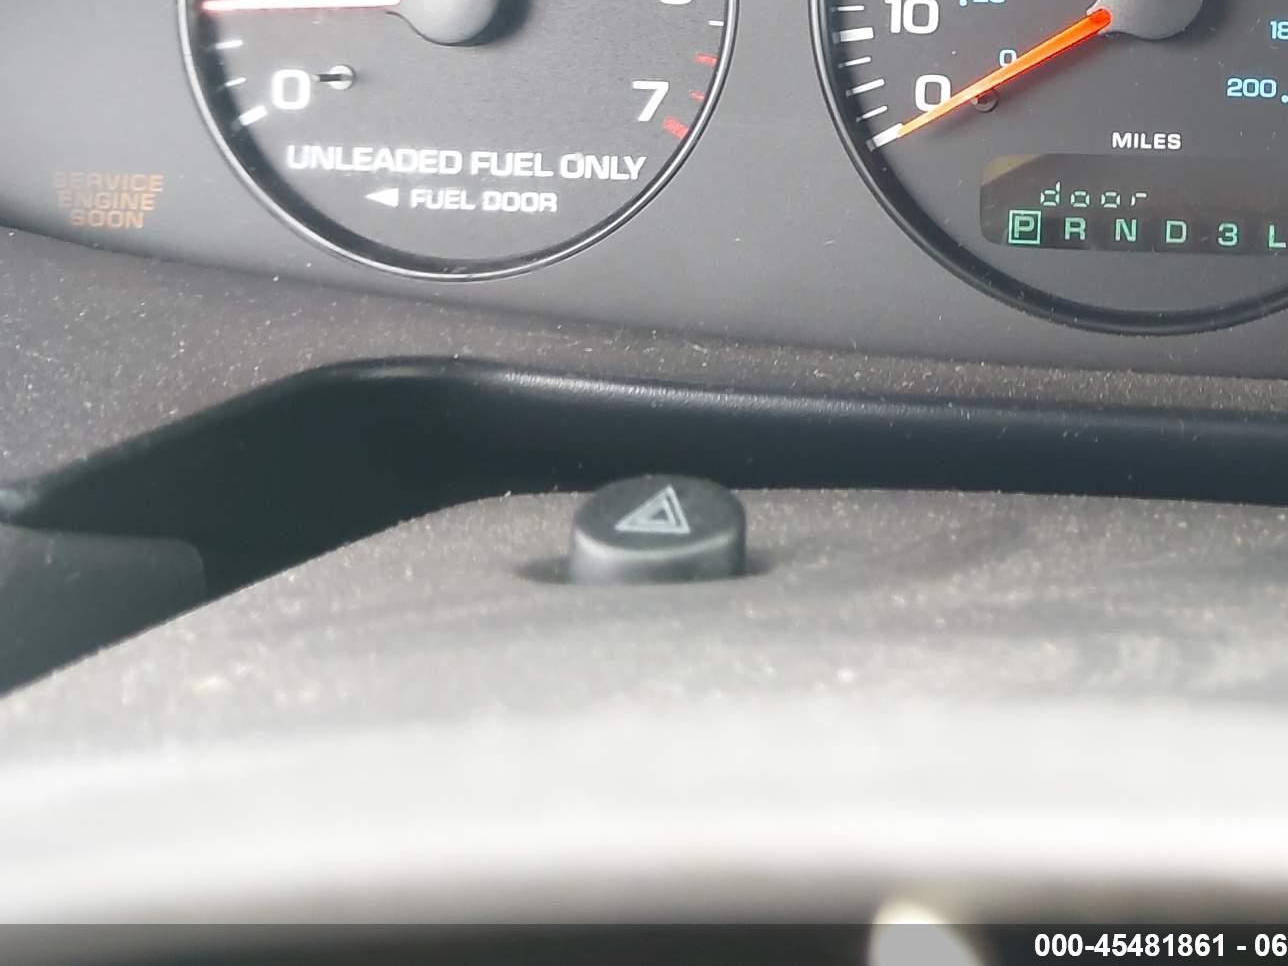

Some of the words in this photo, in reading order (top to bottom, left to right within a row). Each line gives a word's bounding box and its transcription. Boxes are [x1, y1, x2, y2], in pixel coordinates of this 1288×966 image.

[271, 69, 312, 110] 0
[914, 75, 951, 112] 0
[1227, 79, 1277, 98] 200
[631, 81, 670, 122] 7
[1112, 133, 1181, 150] MILES
[287, 146, 463, 175] UNLEADED
[471, 151, 553, 177] FUEL
[561, 152, 647, 182] ONLY
[53, 173, 164, 193] SERVICE
[1040, 181, 1148, 208] door
[59, 192, 156, 212] ENGINE
[410, 190, 476, 211] FUEL
[482, 192, 558, 213] DOOR
[71, 209, 145, 230] SOON
[1014, 215, 1035, 239] P
[1064, 218, 1086, 240] R
[1115, 219, 1136, 241] N
[1166, 221, 1187, 243] D
[1218, 223, 1238, 245] 3
[1268, 226, 1286, 248] L
